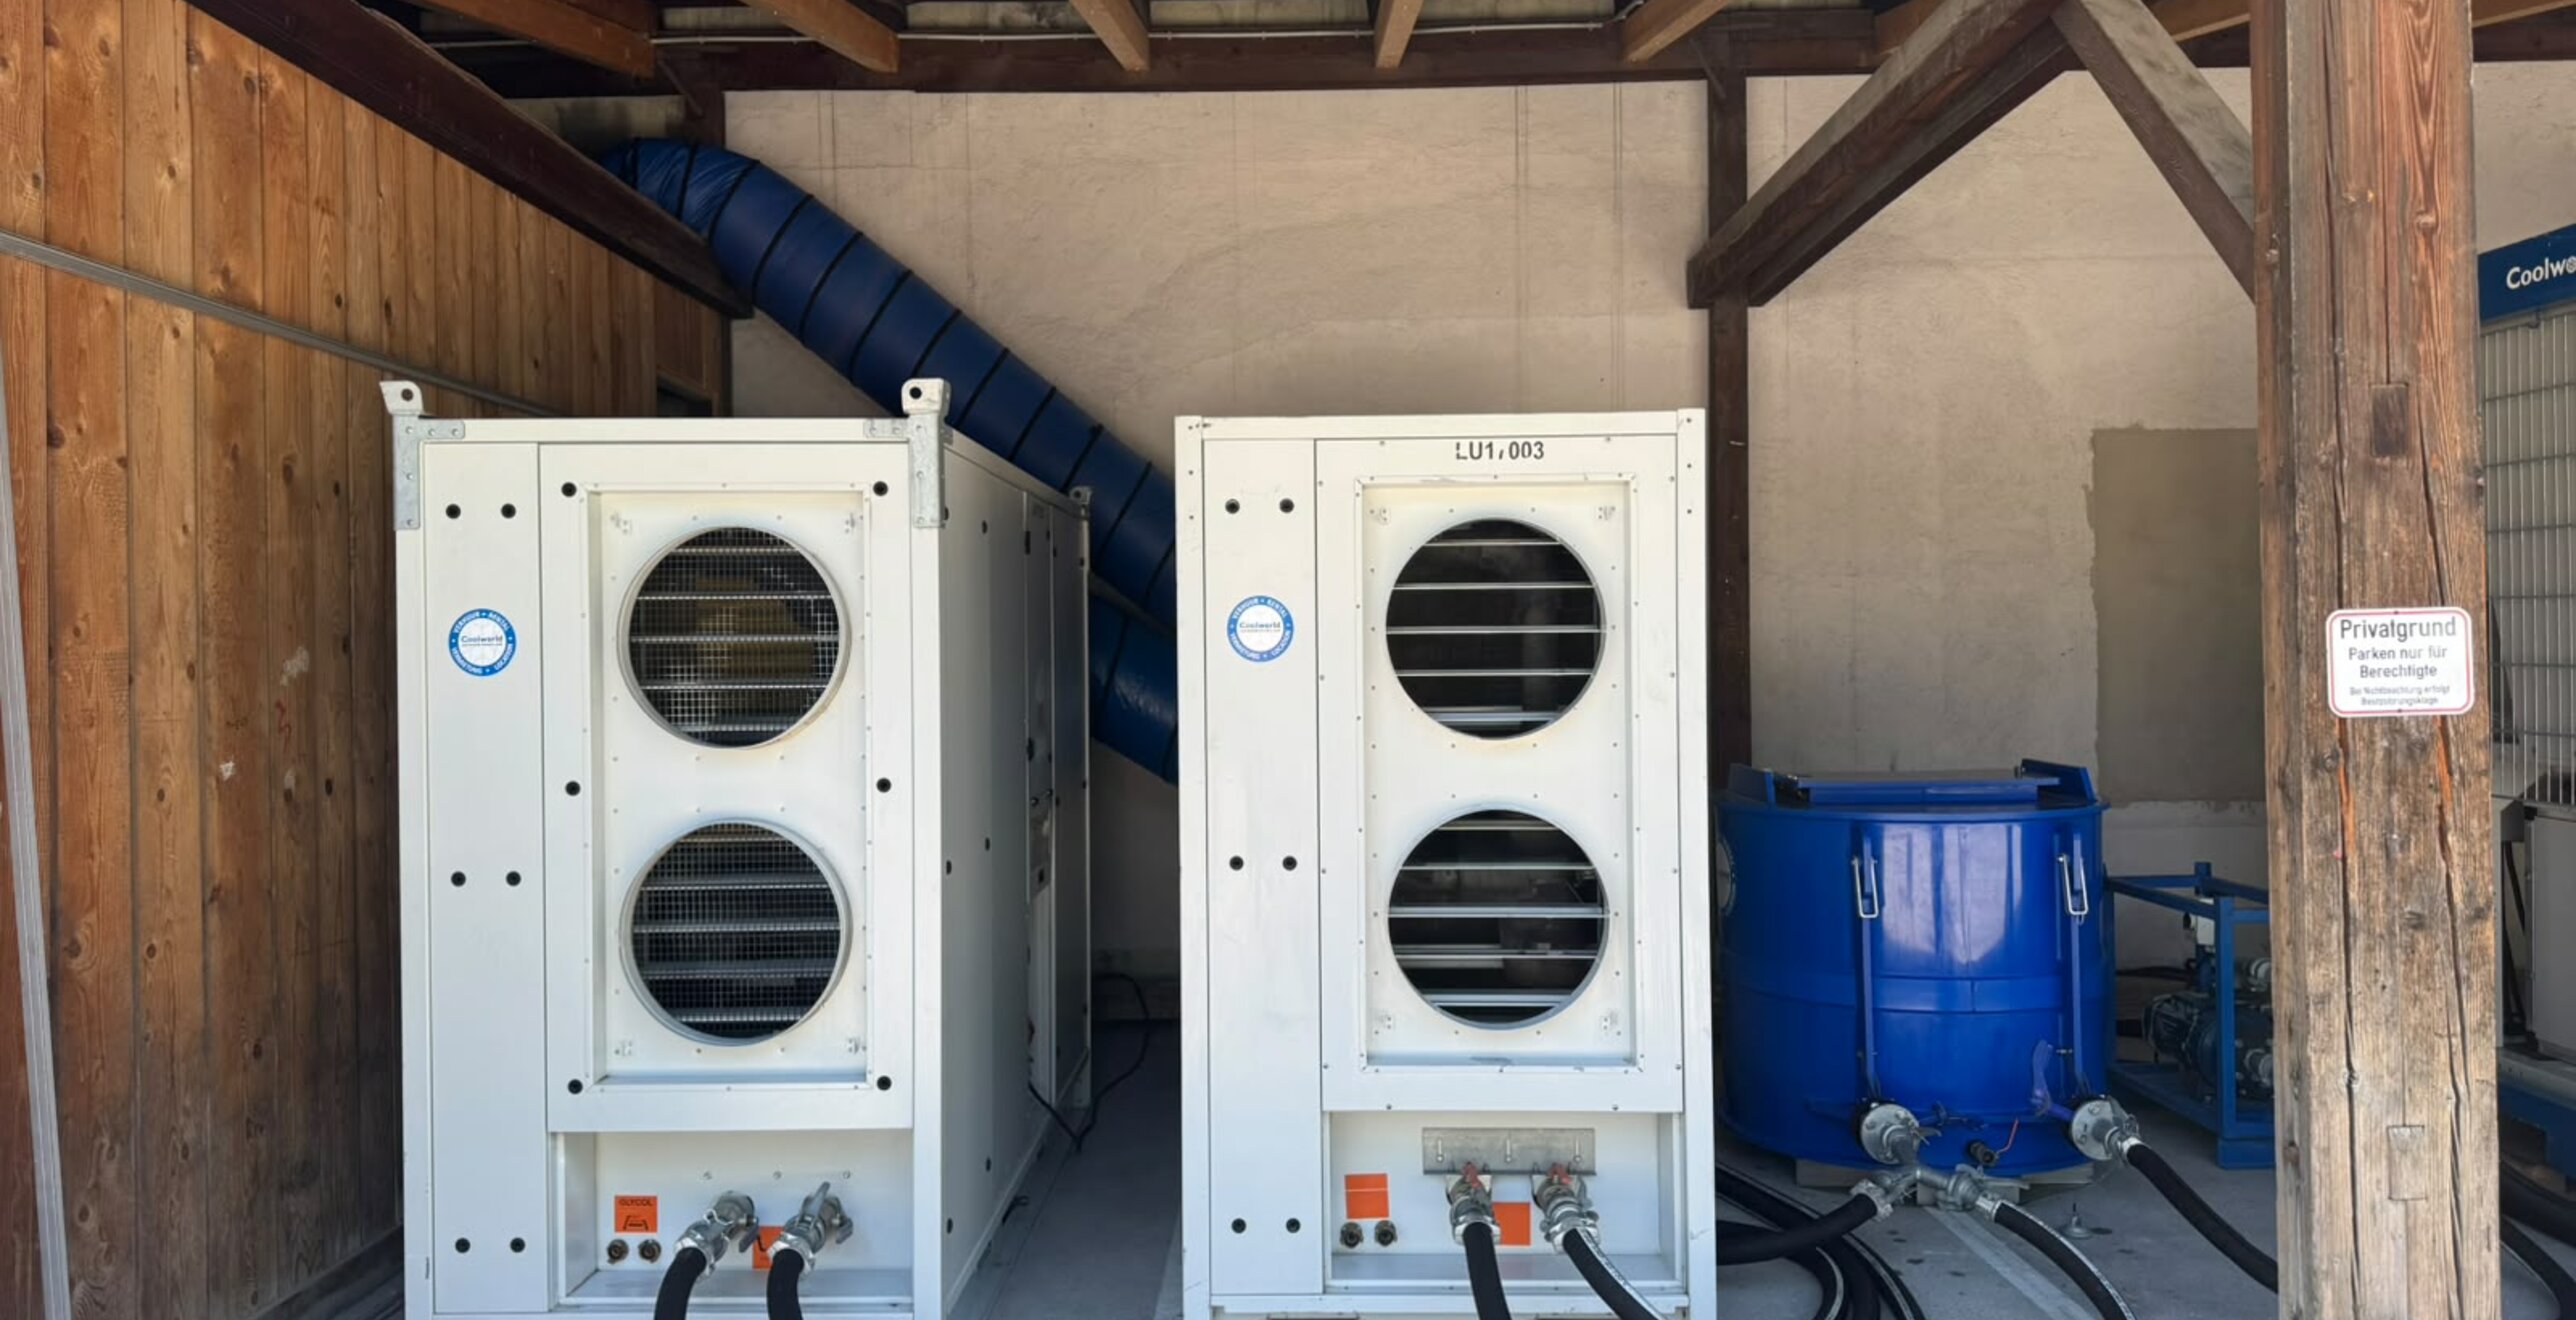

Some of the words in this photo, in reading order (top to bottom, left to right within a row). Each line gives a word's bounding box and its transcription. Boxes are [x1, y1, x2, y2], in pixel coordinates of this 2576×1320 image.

[2340, 616, 2458, 643] Privatgrund
[461, 635, 503, 643] Coolworld
[2348, 647, 2396, 661] Parken
[2399, 648, 2423, 660] nur
[2428, 645, 2448, 659] für
[2360, 664, 2438, 680] Berechtigte
